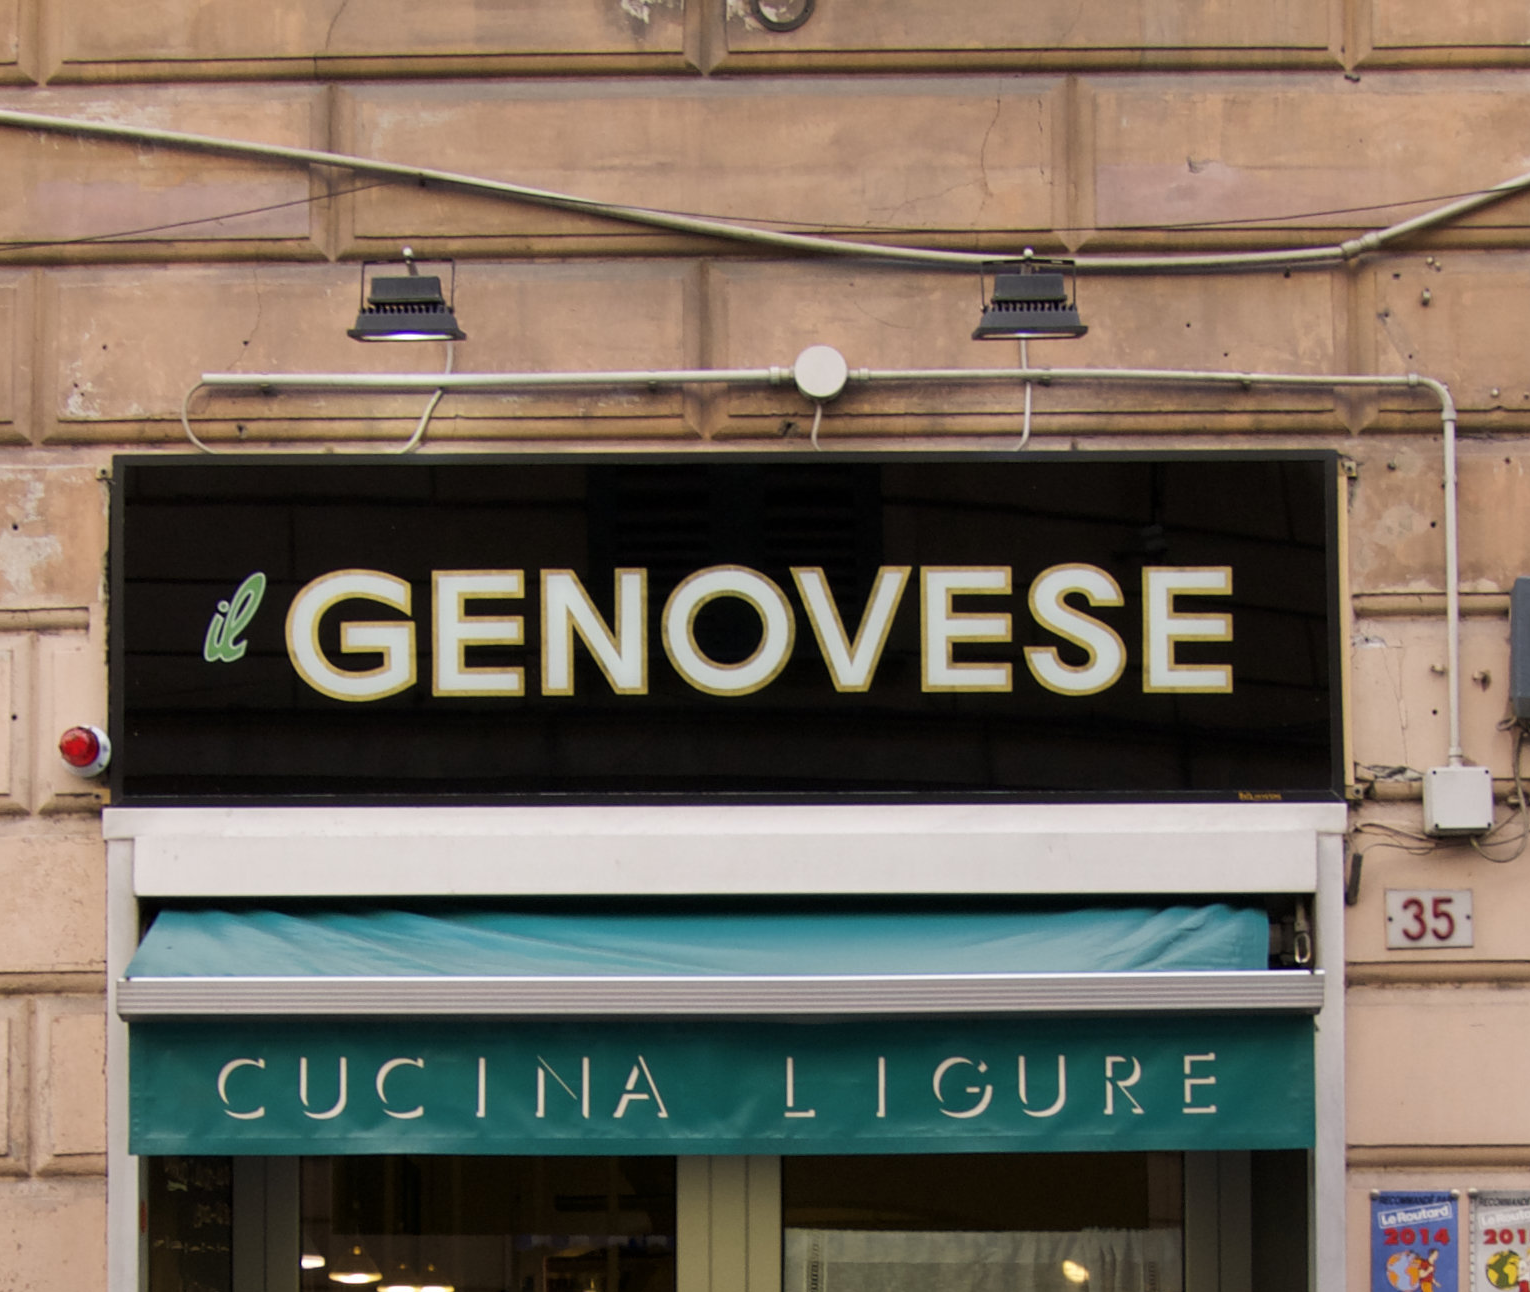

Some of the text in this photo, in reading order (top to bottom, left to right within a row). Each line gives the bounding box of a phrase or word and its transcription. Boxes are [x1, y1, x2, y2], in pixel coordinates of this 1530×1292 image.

[203, 563, 1234, 702] il GENOVESE
[1402, 897, 1456, 941] 35
[216, 1052, 1217, 1120] CUCINA LIGURE
[1384, 1228, 1450, 1245] 2014
[1397, 1206, 1450, 1223] Routard
